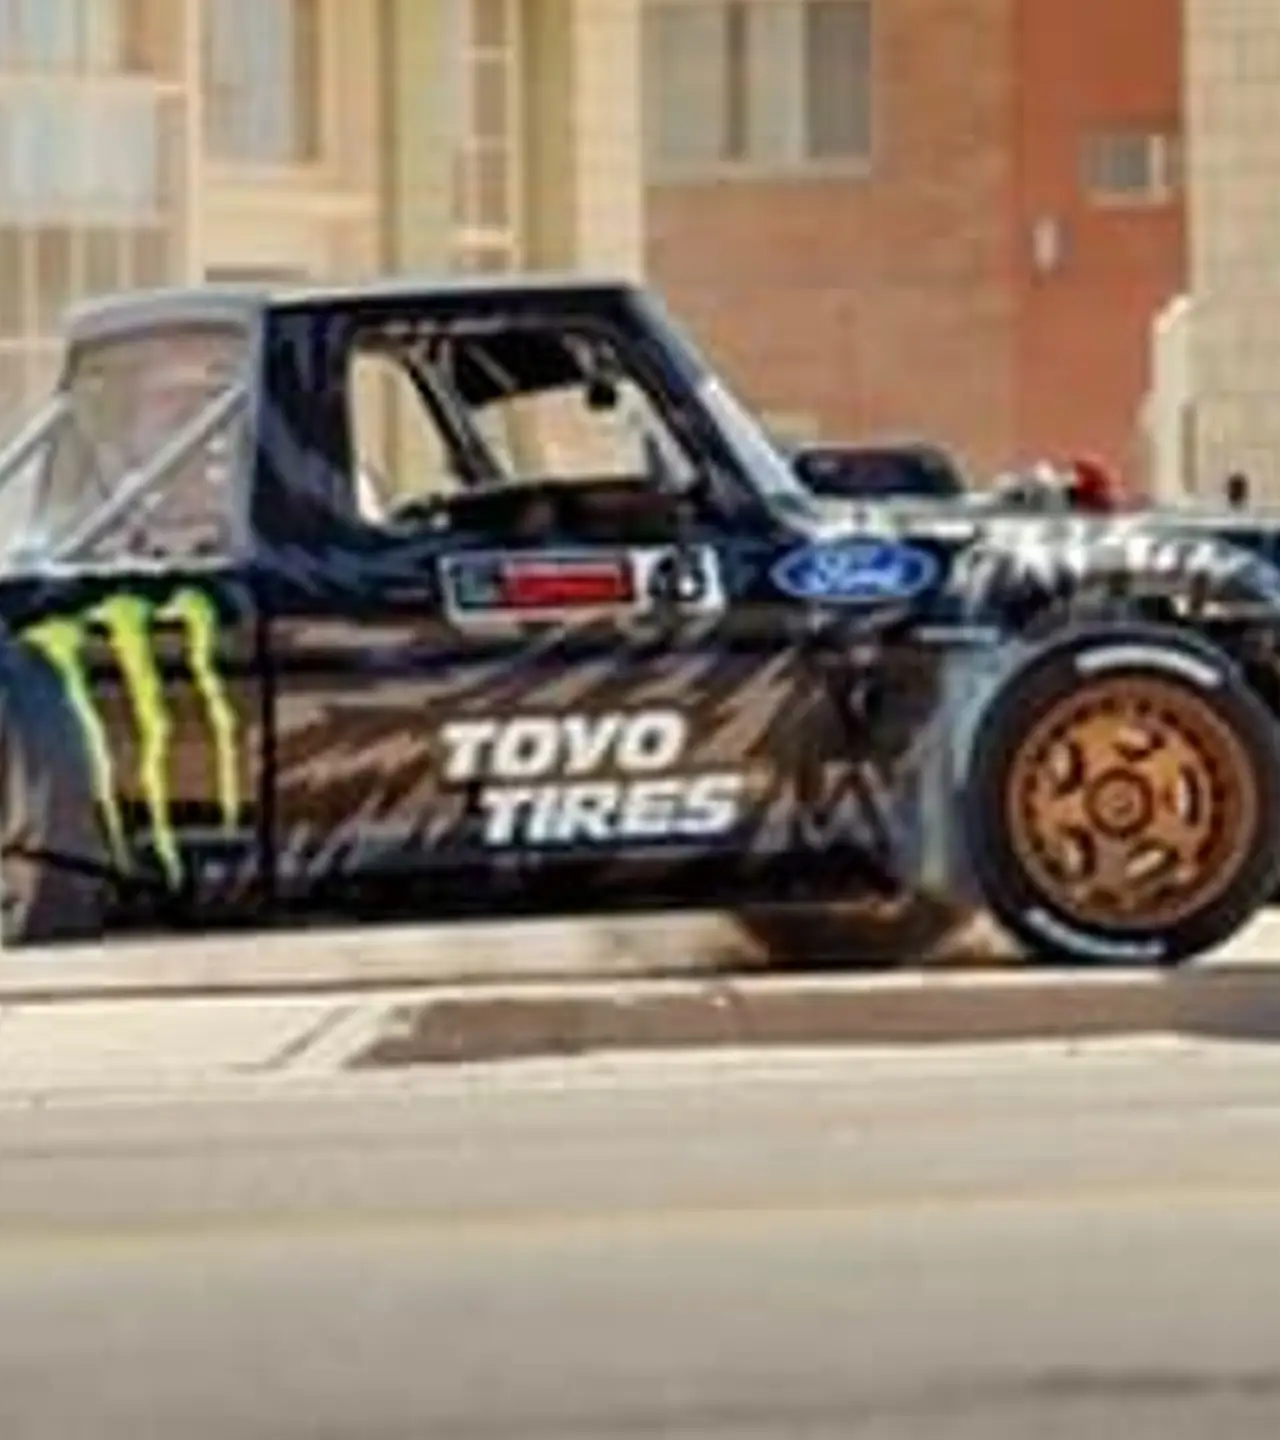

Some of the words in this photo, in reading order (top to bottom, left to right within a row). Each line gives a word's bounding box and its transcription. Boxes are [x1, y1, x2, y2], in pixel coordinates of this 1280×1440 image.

[790, 544, 918, 598] Ford
[440, 711, 687, 778] TOYO
[480, 773, 744, 844] TIRES
